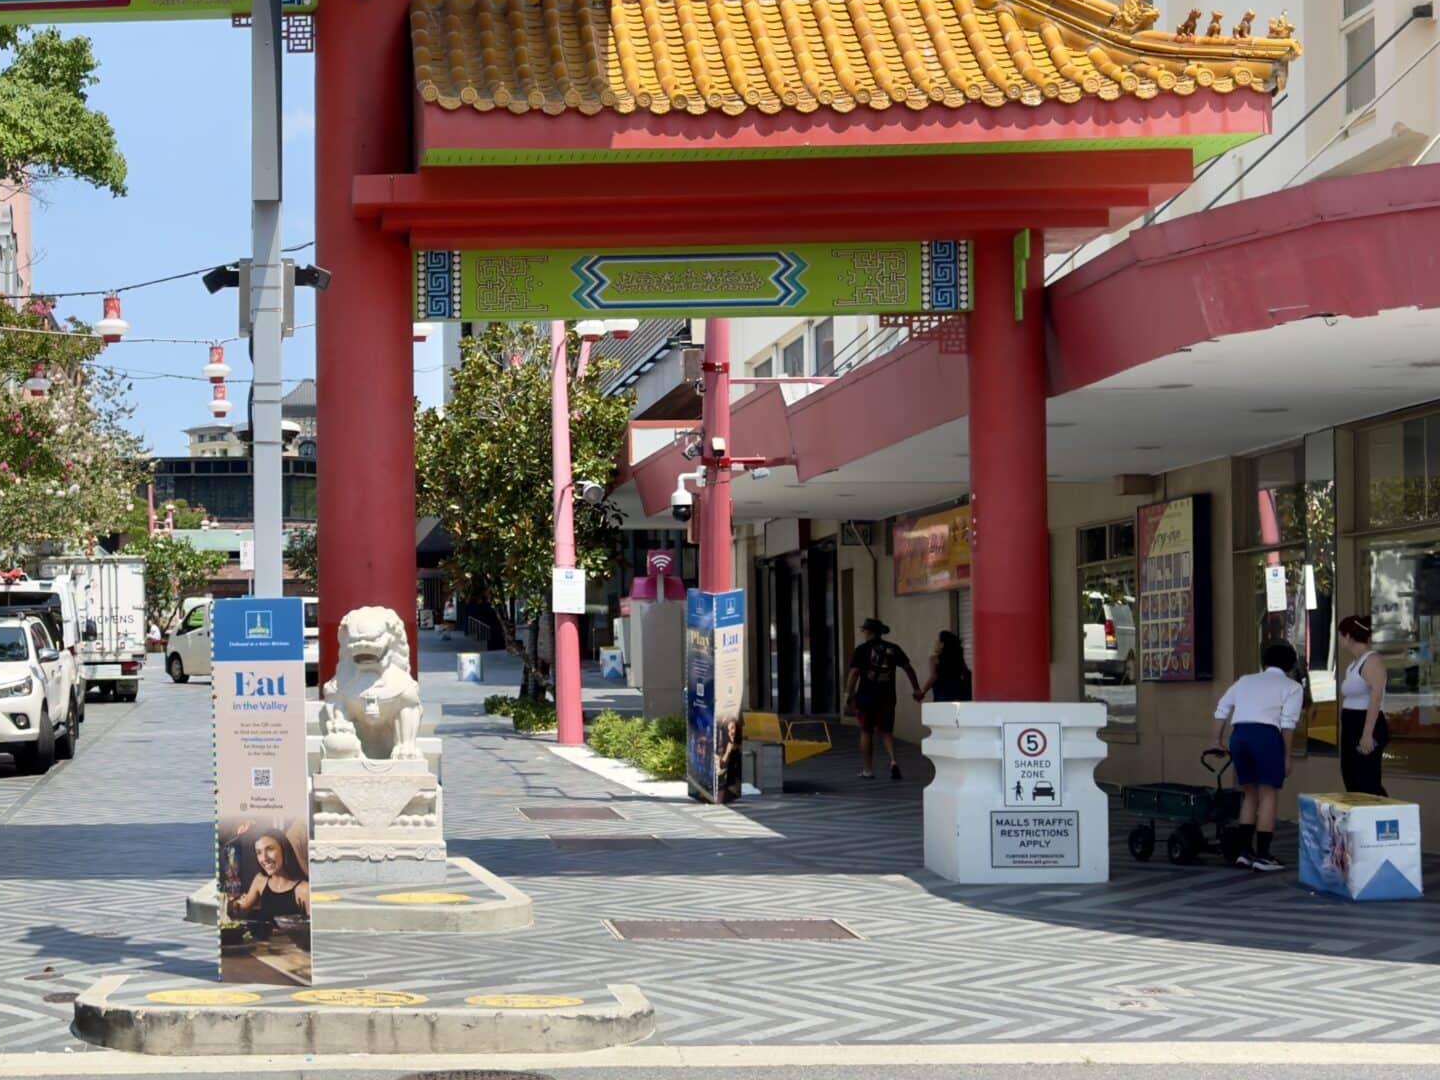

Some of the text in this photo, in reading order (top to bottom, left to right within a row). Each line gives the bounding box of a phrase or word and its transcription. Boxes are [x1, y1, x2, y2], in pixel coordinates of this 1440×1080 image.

[235, 672, 288, 696] Eat
[233, 701, 288, 713] in the Valley
[1027, 735, 1039, 752] 5
[1014, 760, 1051, 768] SHARED
[1021, 770, 1045, 779] ZONE
[995, 817, 1073, 827] MALLS TRAFFIC
[1000, 829, 1070, 838] RESTRICTIONS
[1019, 840, 1051, 849] APPLY
